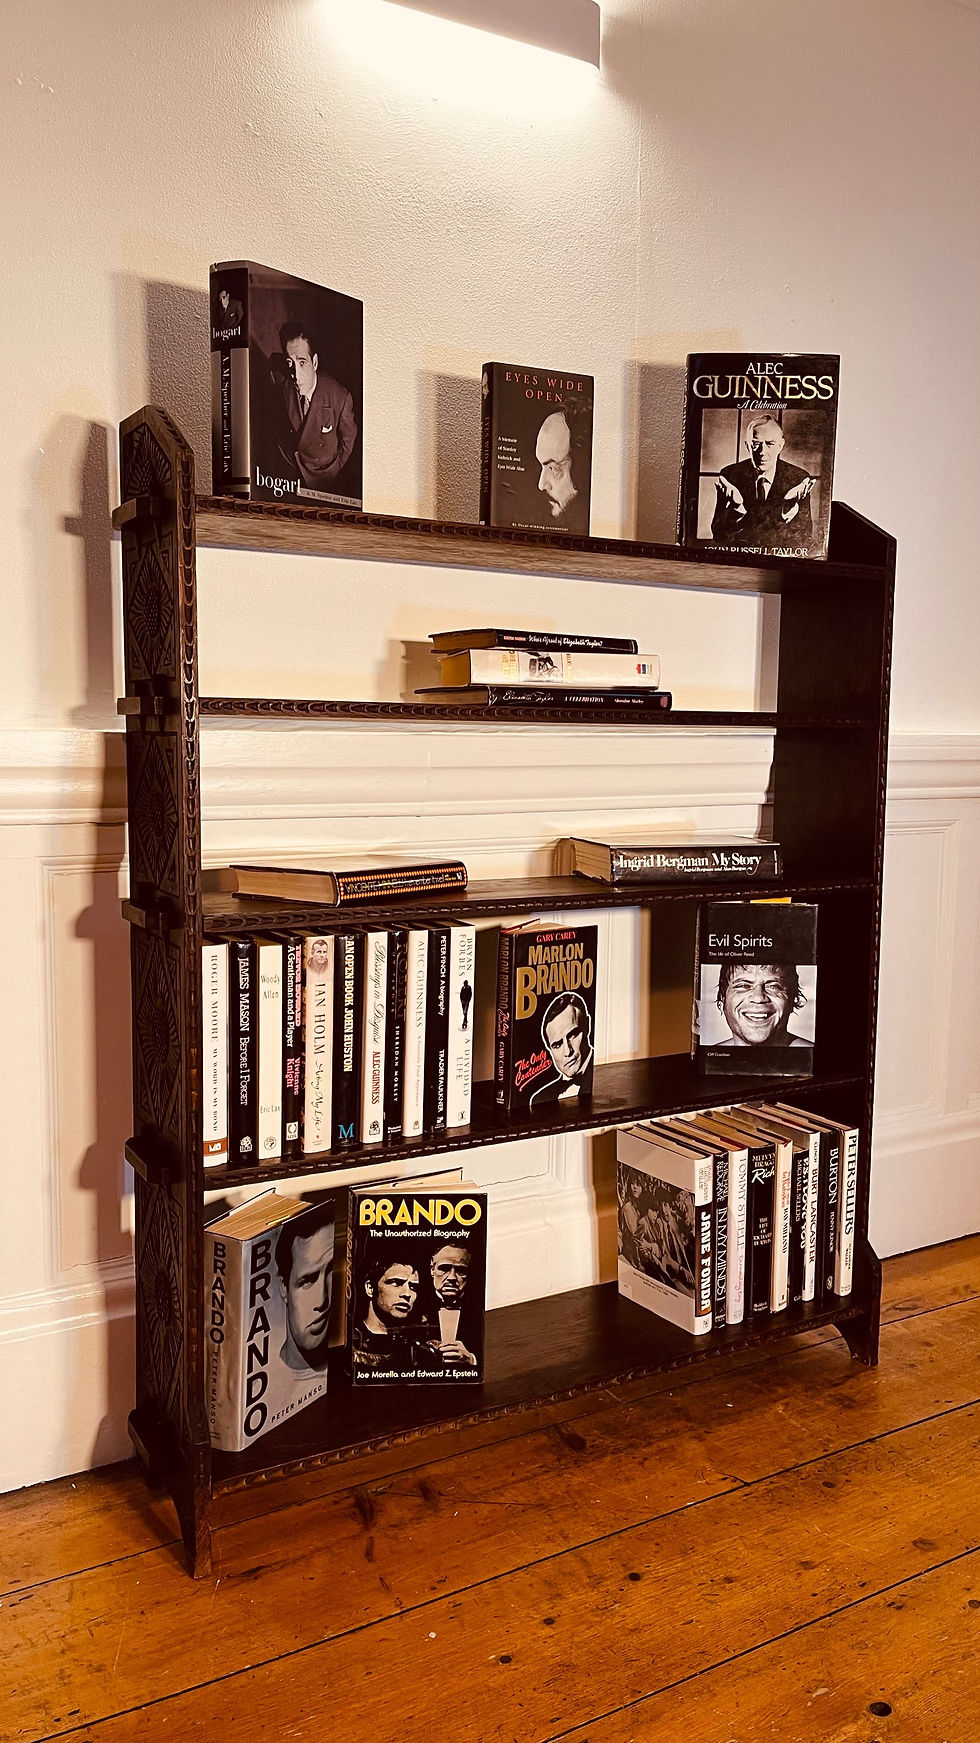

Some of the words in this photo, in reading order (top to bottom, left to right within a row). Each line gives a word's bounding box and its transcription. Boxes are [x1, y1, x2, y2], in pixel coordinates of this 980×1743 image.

[212, 325, 241, 341] bogart
[505, 371, 538, 385] EYES
[546, 377, 583, 392] WIDE
[745, 362, 784, 375] ALEC
[221, 381, 230, 417] Sperber
[525, 388, 563, 402] OPEN
[692, 375, 834, 400] GUINNESS
[736, 400, 748, 409] A
[748, 399, 788, 411] Celebration
[223, 456, 231, 473] Lax
[256, 466, 301, 497] bogart
[771, 547, 809, 557] TAYLOR
[618, 854, 654, 871] Ingrid
[656, 854, 708, 870] Bergman
[711, 852, 730, 866] My
[731, 852, 762, 875] Story
[345, 940, 355, 955] AN
[536, 933, 555, 943] GARY
[555, 931, 576, 941] CAREY
[708, 934, 729, 947] Evil
[733, 934, 773, 950] Spirits
[369, 941, 386, 990] Blessings
[416, 940, 425, 967] ALEC
[500, 937, 509, 974] MARLON
[528, 942, 584, 966] MARLON
[210, 954, 218, 996] ROGER
[238, 957, 249, 989] JAMES
[260, 974, 280, 985] Woody
[345, 955, 354, 979] OPEN
[262, 990, 279, 999] Allen
[314, 983, 325, 1007] IAN
[344, 980, 354, 1006] BOOK
[373, 991, 381, 999] in
[415, 970, 425, 1028] GUINNESS
[438, 985, 446, 1016] biography
[499, 974, 509, 1009] BRANDO
[515, 958, 594, 1020] BRANDO
[239, 993, 250, 1031] MASON
[344, 1008, 354, 1033] JOHN
[368, 1000, 385, 1044] Disguise
[286, 1022, 294, 1048] Player
[313, 1013, 325, 1055] HOLM
[212, 1048, 218, 1058] MY
[343, 1033, 353, 1072] HUSTON
[372, 1051, 380, 1069] ALEC
[514, 1058, 530, 1074] The
[530, 1050, 547, 1064] Only
[285, 1058, 294, 1088] Knight
[463, 1049, 471, 1096] DIVIDED
[514, 1060, 552, 1088] Contender
[239, 1074, 250, 1106] FORGET
[371, 1069, 380, 1104] GUINNESS
[212, 1097, 218, 1108] MY
[260, 1104, 270, 1114] Eric
[310, 1092, 324, 1109] My
[847, 1134, 857, 1178] PETER
[738, 1158, 746, 1200] TOMMY
[751, 1165, 775, 1185] Rich
[828, 1147, 838, 1204] BURTON
[359, 1198, 482, 1226] BRANDO
[718, 1208, 728, 1223] IN
[845, 1179, 855, 1235] SELLERS
[369, 1229, 383, 1237] The
[384, 1229, 432, 1237] Unauthorized
[433, 1229, 470, 1239] Biography
[700, 1211, 711, 1255] JANE
[718, 1224, 728, 1248] MY
[737, 1203, 745, 1251] STEELE
[808, 1200, 817, 1263] LANCASTER
[209, 1241, 226, 1345] BRANDO
[700, 1258, 711, 1311] FONDA
[243, 1238, 272, 1438] BRANDO
[356, 1371, 369, 1379] Joe
[371, 1370, 399, 1378] Morella
[401, 1370, 416, 1378] and
[452, 1370, 478, 1378] Epstein
[271, 1402, 295, 1424] PETER
[297, 1384, 323, 1406] MANSO
